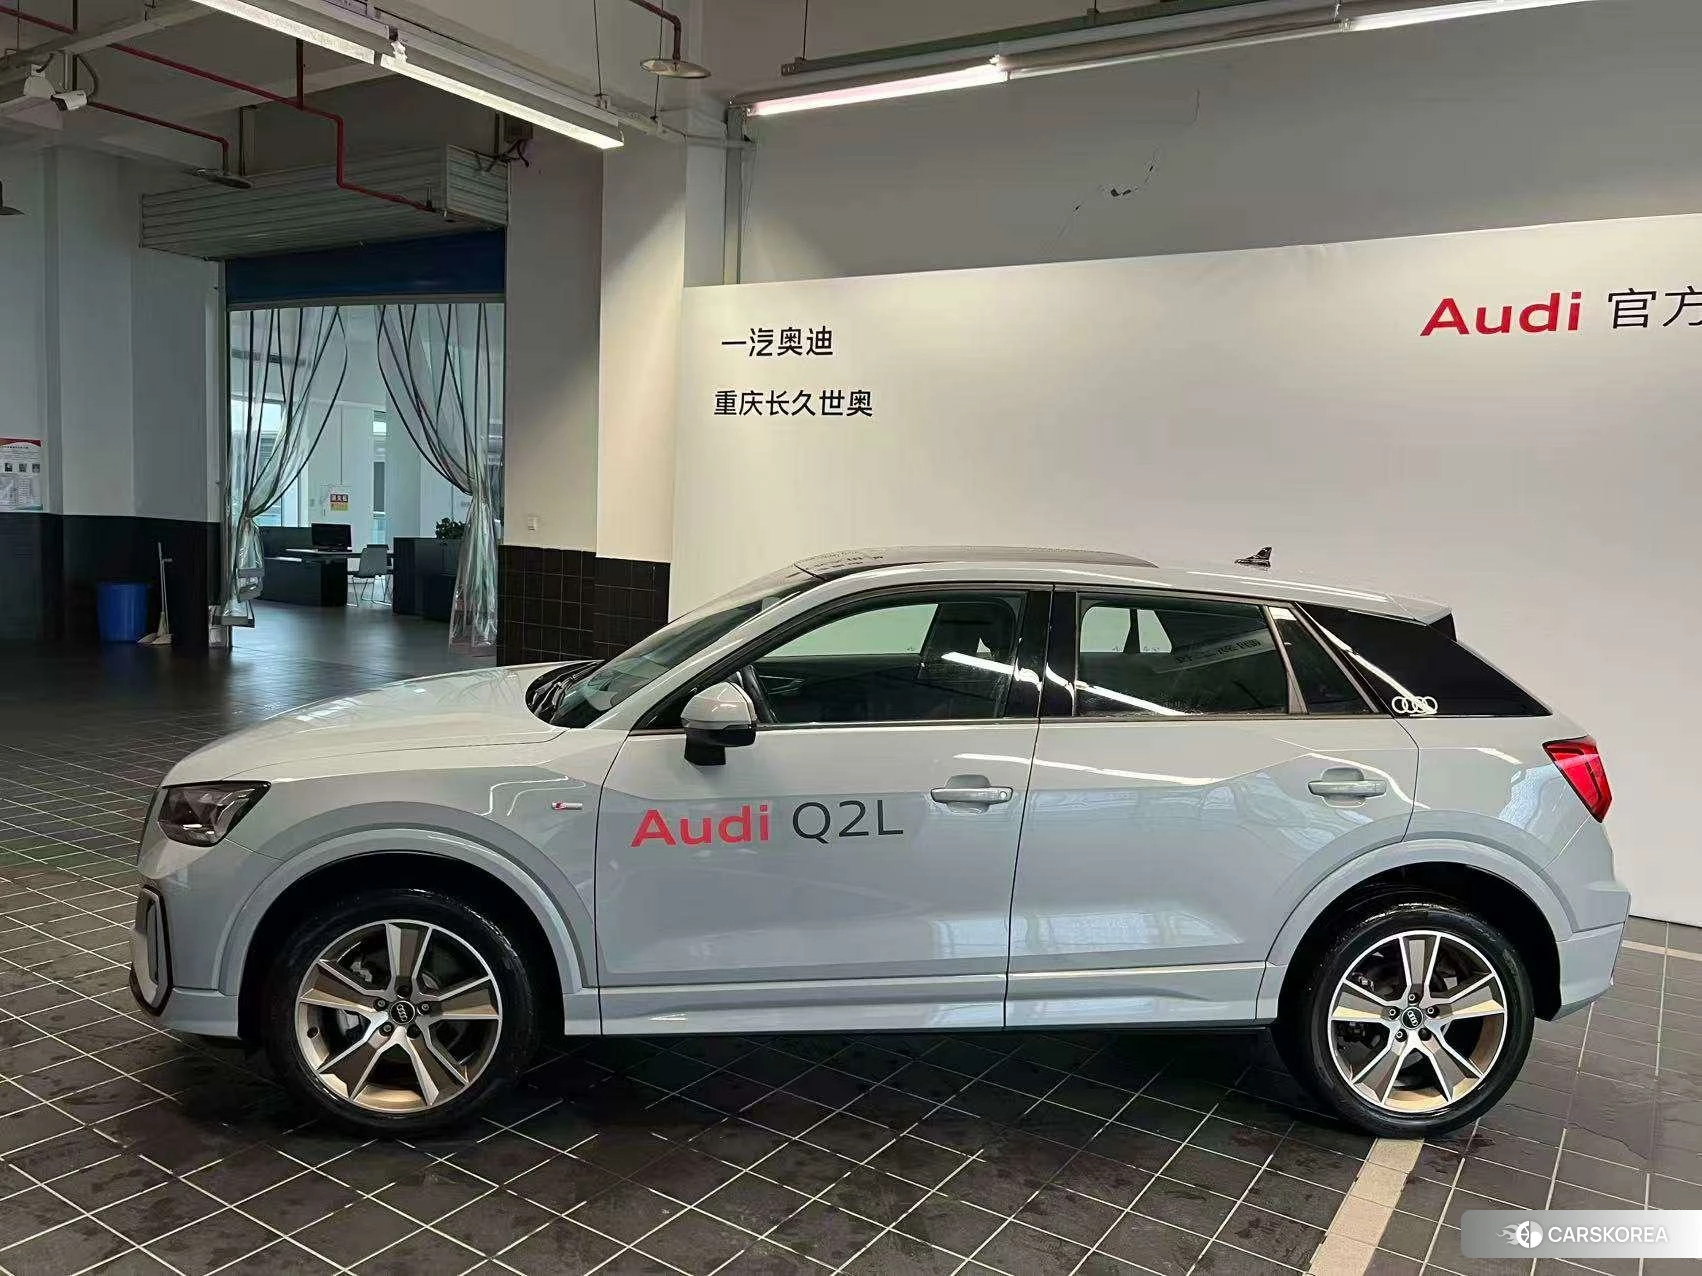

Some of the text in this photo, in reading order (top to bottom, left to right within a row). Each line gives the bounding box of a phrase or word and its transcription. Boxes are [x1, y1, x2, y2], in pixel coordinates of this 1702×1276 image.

[1420, 285, 1702, 337] Audi 官方
[721, 325, 834, 357] 一汽奥迪
[713, 389, 873, 417] 重庆长久世奥
[631, 799, 904, 848] Audi Q2L
